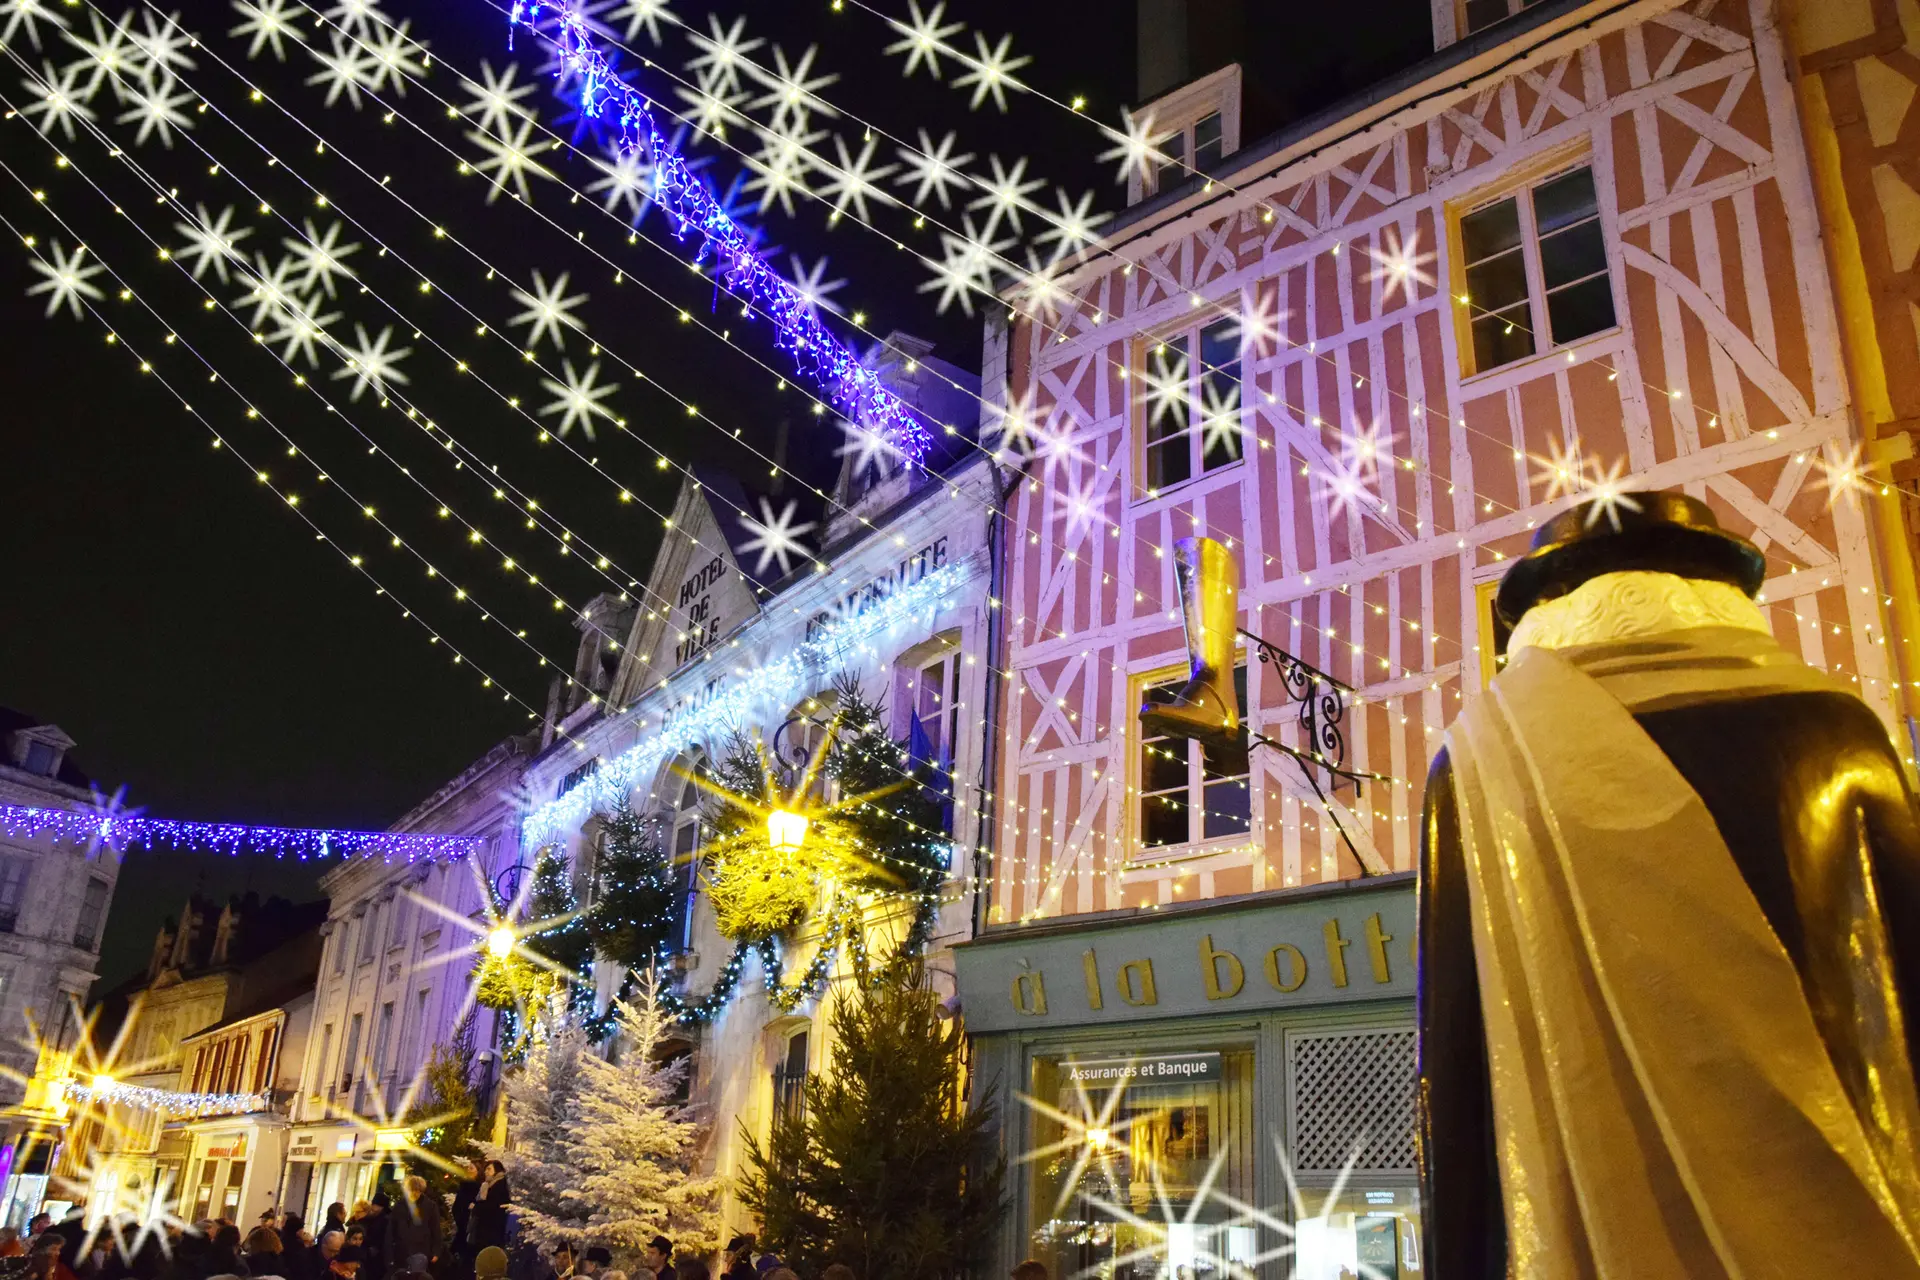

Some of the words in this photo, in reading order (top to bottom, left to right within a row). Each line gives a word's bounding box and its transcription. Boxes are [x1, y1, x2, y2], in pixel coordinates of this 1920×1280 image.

[679, 552, 727, 609] HOTEL
[688, 594, 710, 631] DE
[675, 616, 720, 667] VILLE
[1010, 957, 1047, 1016] à
[1083, 947, 1158, 1011] la
[1199, 912, 1417, 1002] bott
[1070, 1066, 1137, 1081] Assurances
[1141, 1063, 1154, 1076] et
[1158, 1061, 1207, 1078] Banque
